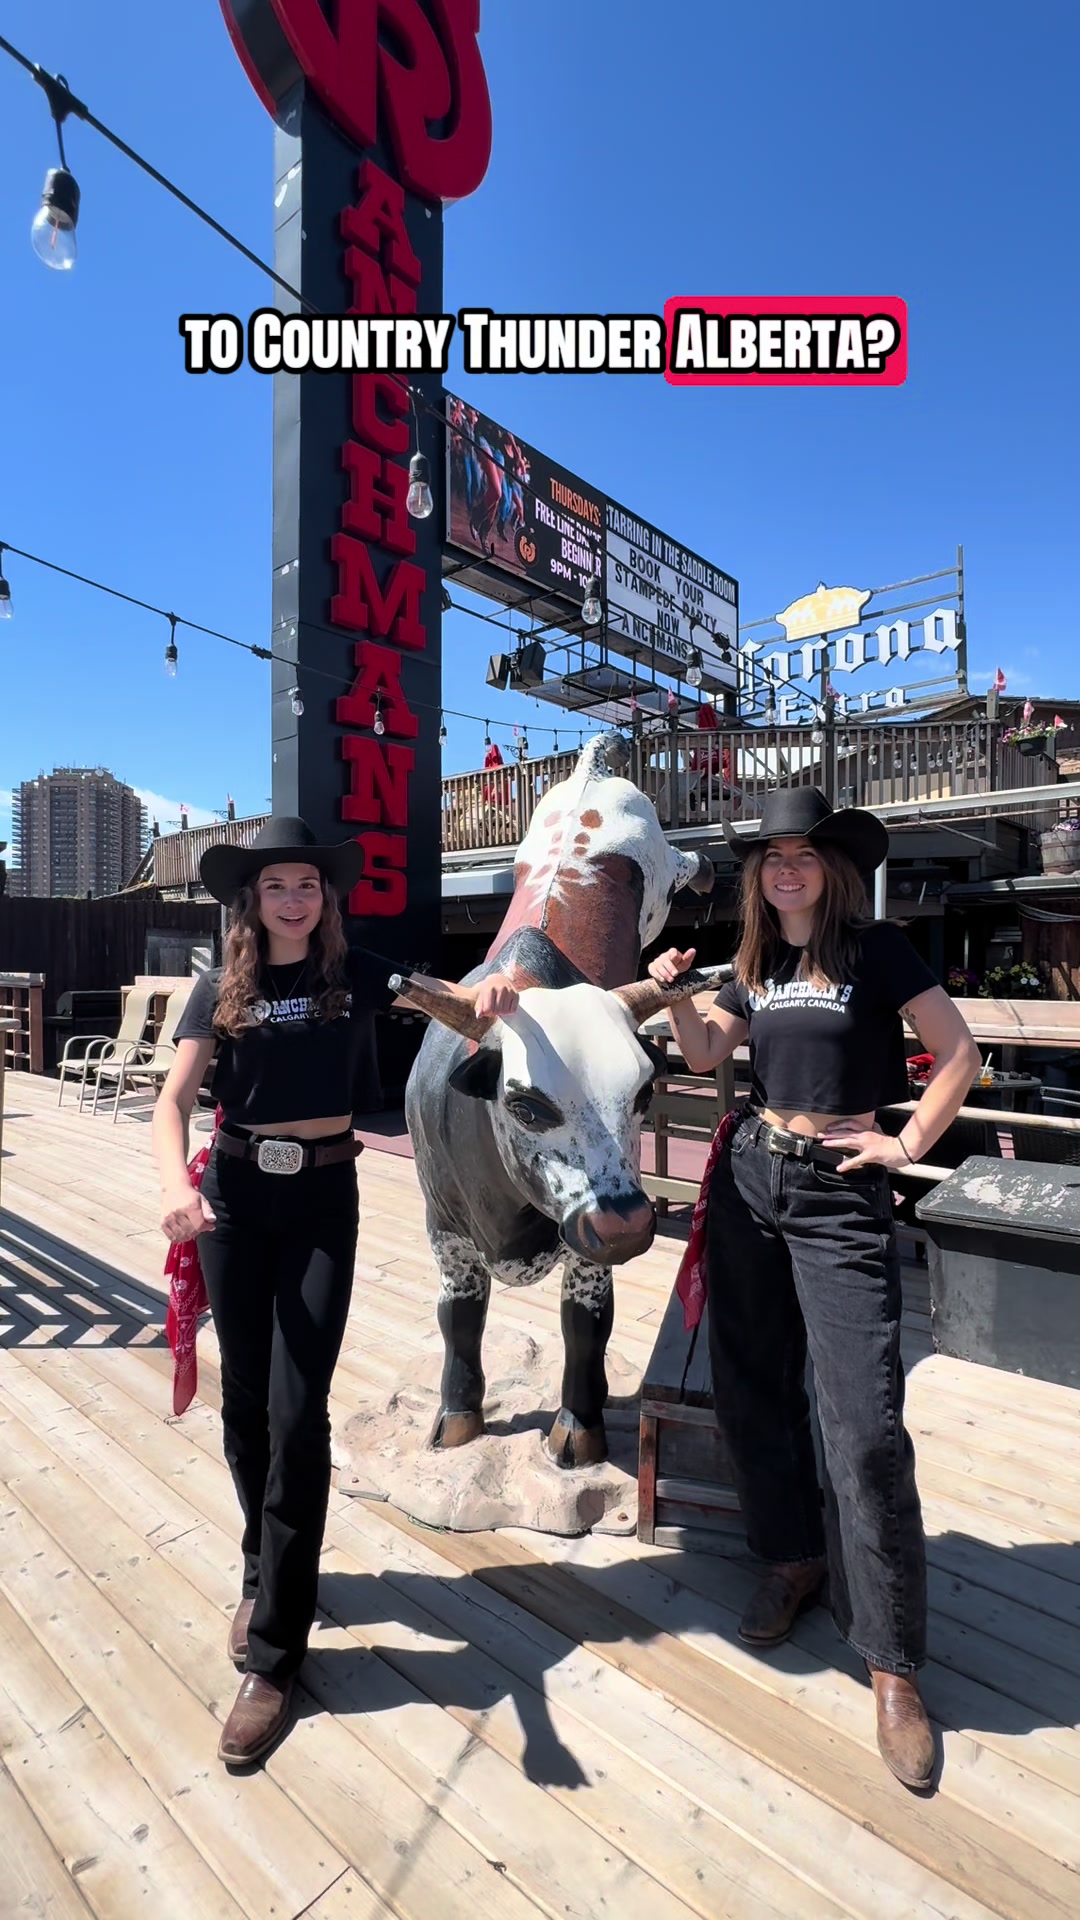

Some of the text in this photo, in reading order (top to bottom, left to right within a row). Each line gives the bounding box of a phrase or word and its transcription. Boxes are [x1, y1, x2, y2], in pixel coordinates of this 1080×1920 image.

[535, 497, 556, 529] FREE
[556, 512, 575, 541] LINE
[549, 477, 601, 528] THURSDAYS:
[550, 558, 572, 581] 9PM
[561, 537, 602, 578] BEGINNR
[629, 548, 704, 608] BOOK YOUR
[651, 533, 662, 559] IN
[663, 541, 680, 570] THE
[681, 553, 713, 589] SADDLE
[713, 572, 735, 604] ROOM
[615, 563, 676, 613] STAMPEDE
[656, 608, 680, 636] NOW
[807, 998, 846, 1014] CANADA
